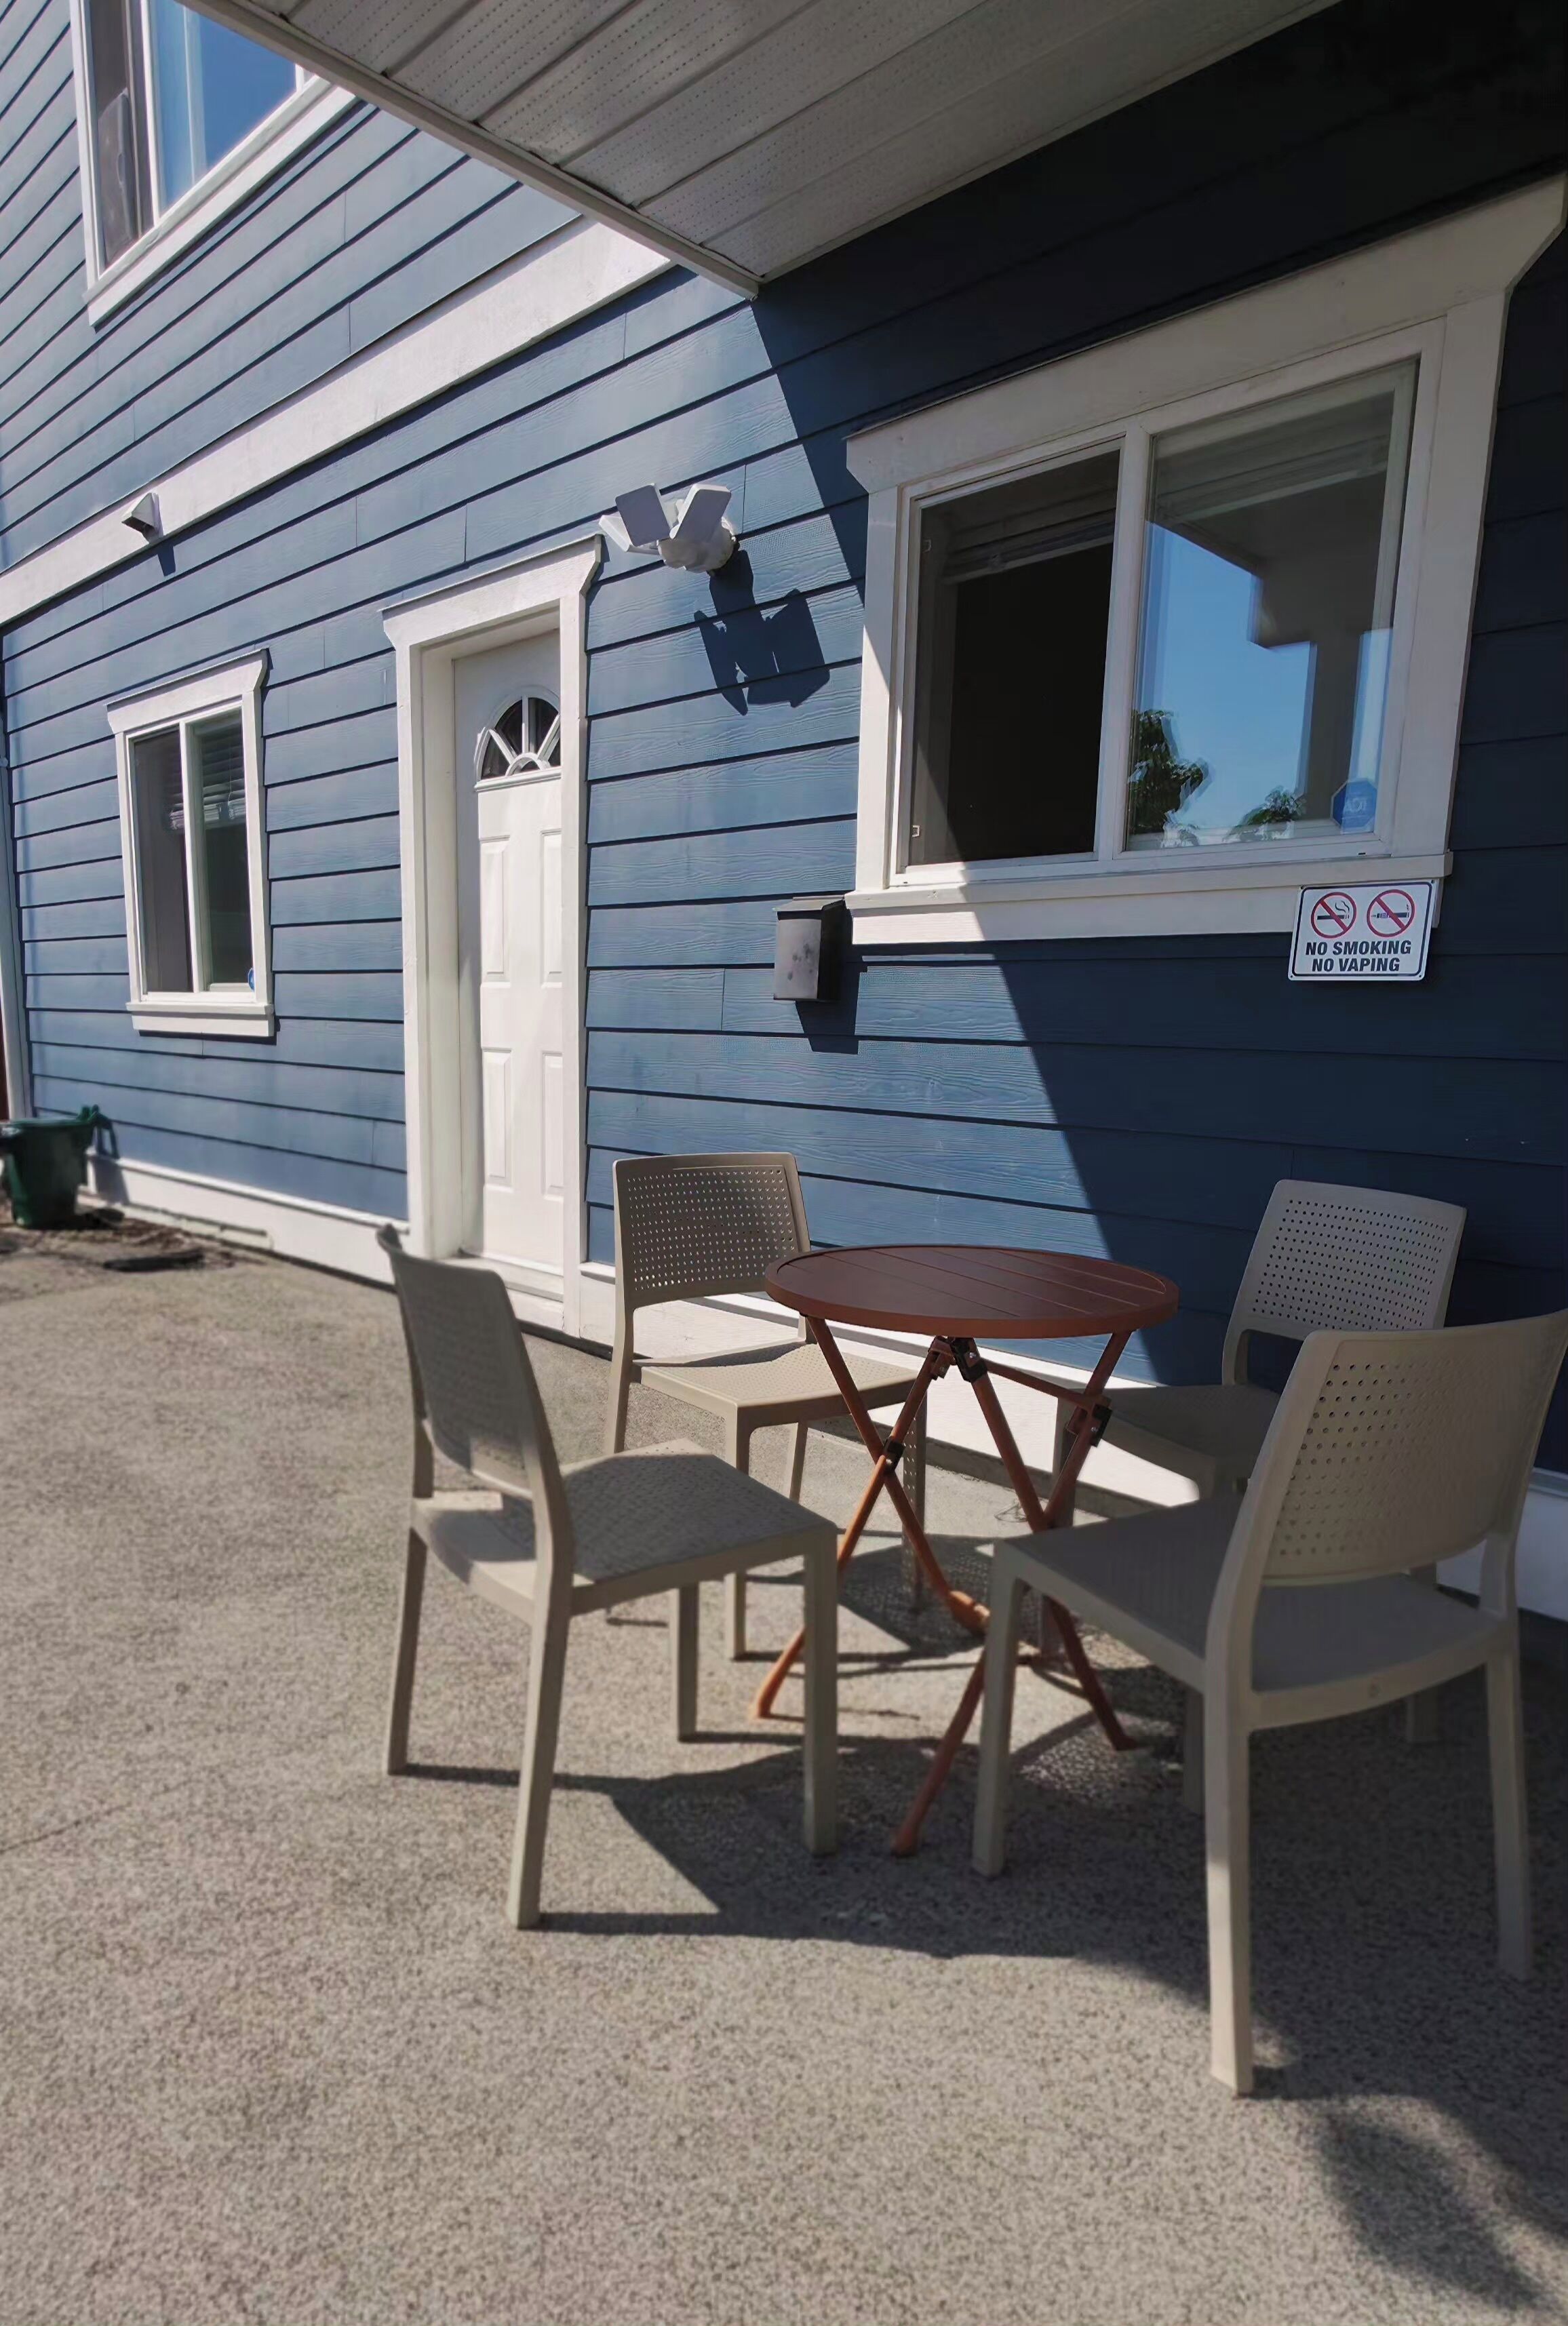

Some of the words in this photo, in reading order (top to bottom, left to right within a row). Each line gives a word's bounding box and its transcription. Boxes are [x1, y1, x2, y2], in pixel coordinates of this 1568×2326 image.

[1306, 942, 1327, 955] NO
[1333, 940, 1411, 955] SMOKING
[1312, 958, 1334, 972] NO
[1339, 958, 1400, 972] VAPING
